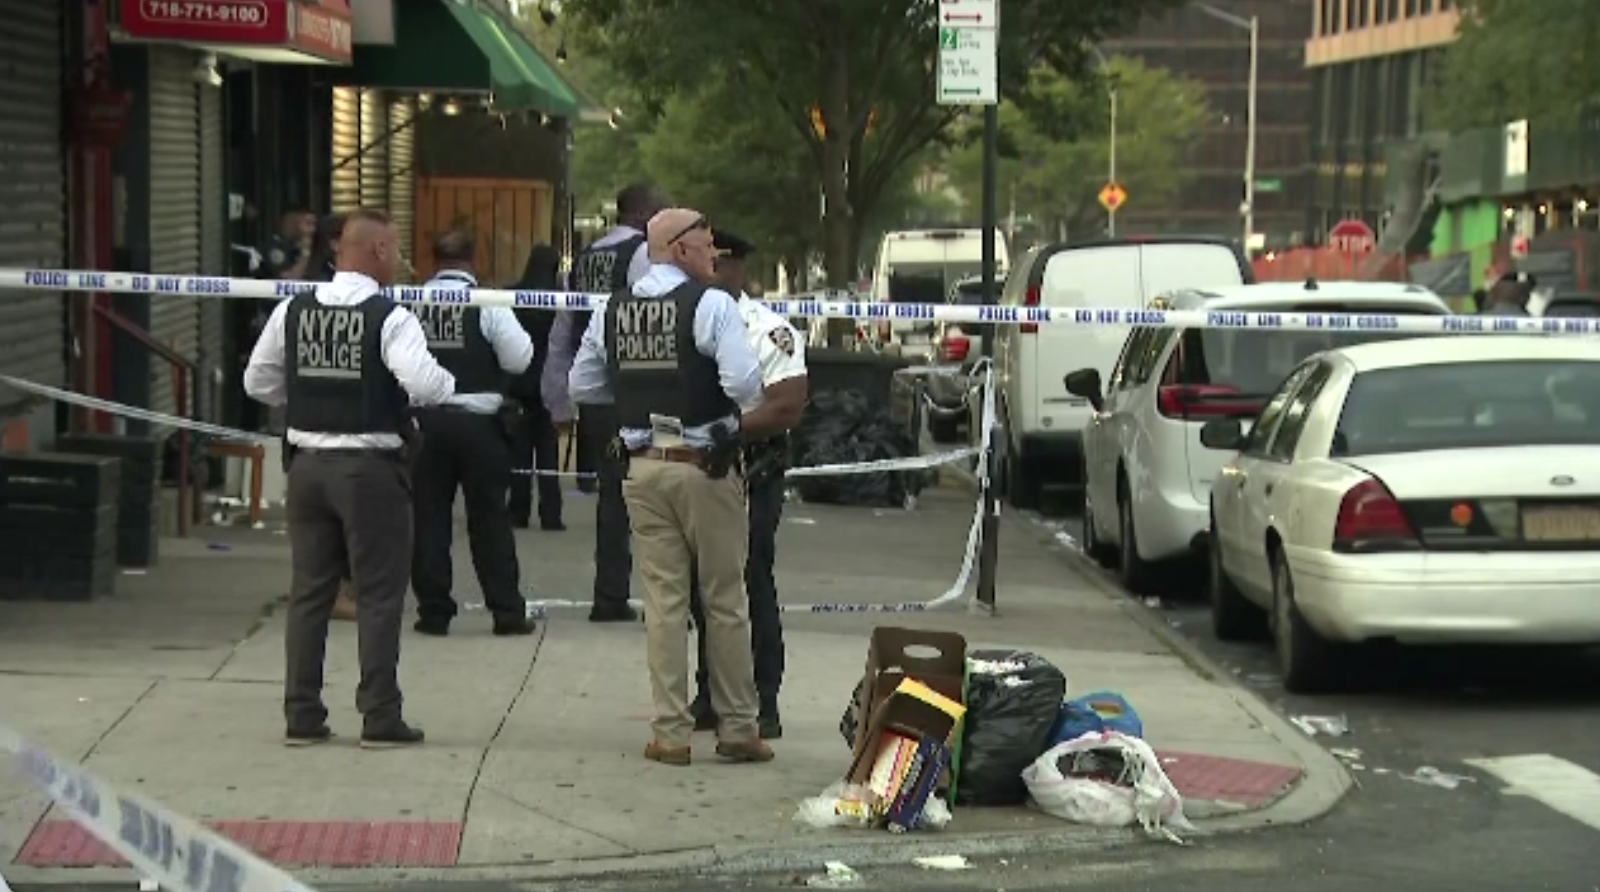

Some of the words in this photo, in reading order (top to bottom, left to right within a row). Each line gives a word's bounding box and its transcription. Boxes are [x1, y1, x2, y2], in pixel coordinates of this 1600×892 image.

[150, 1, 260, 22] 718-771-9100
[1329, 235, 1376, 253] STOP
[25, 271, 69, 286] POLICE
[79, 273, 105, 288] LINE
[132, 276, 150, 290] DO
[155, 277, 181, 291] NOT
[186, 279, 231, 293] CROSS
[401, 288, 424, 301] NOT
[430, 289, 471, 303] CROSS
[515, 292, 557, 306] POLICE
[566, 294, 590, 307] LINE
[616, 301, 678, 334] NYPD
[868, 305, 890, 317] NOT
[895, 305, 934, 317] CROSS
[979, 307, 1019, 321] POLICE
[1027, 308, 1051, 321] LINE
[1075, 309, 1092, 322] DO
[1097, 310, 1120, 323] NOT
[1125, 310, 1165, 323] CROSS
[1207, 312, 1248, 326] POLICE
[1258, 314, 1282, 326] LINE
[1306, 314, 1323, 327] DO
[1329, 315, 1350, 328] NOT
[1357, 314, 1399, 328] CROSS
[298, 309, 365, 343] NYPD
[1443, 317, 1482, 331] POLICE
[1494, 318, 1518, 331] LINE
[297, 342, 362, 369] POLICE
[616, 334, 678, 360] POLICE
